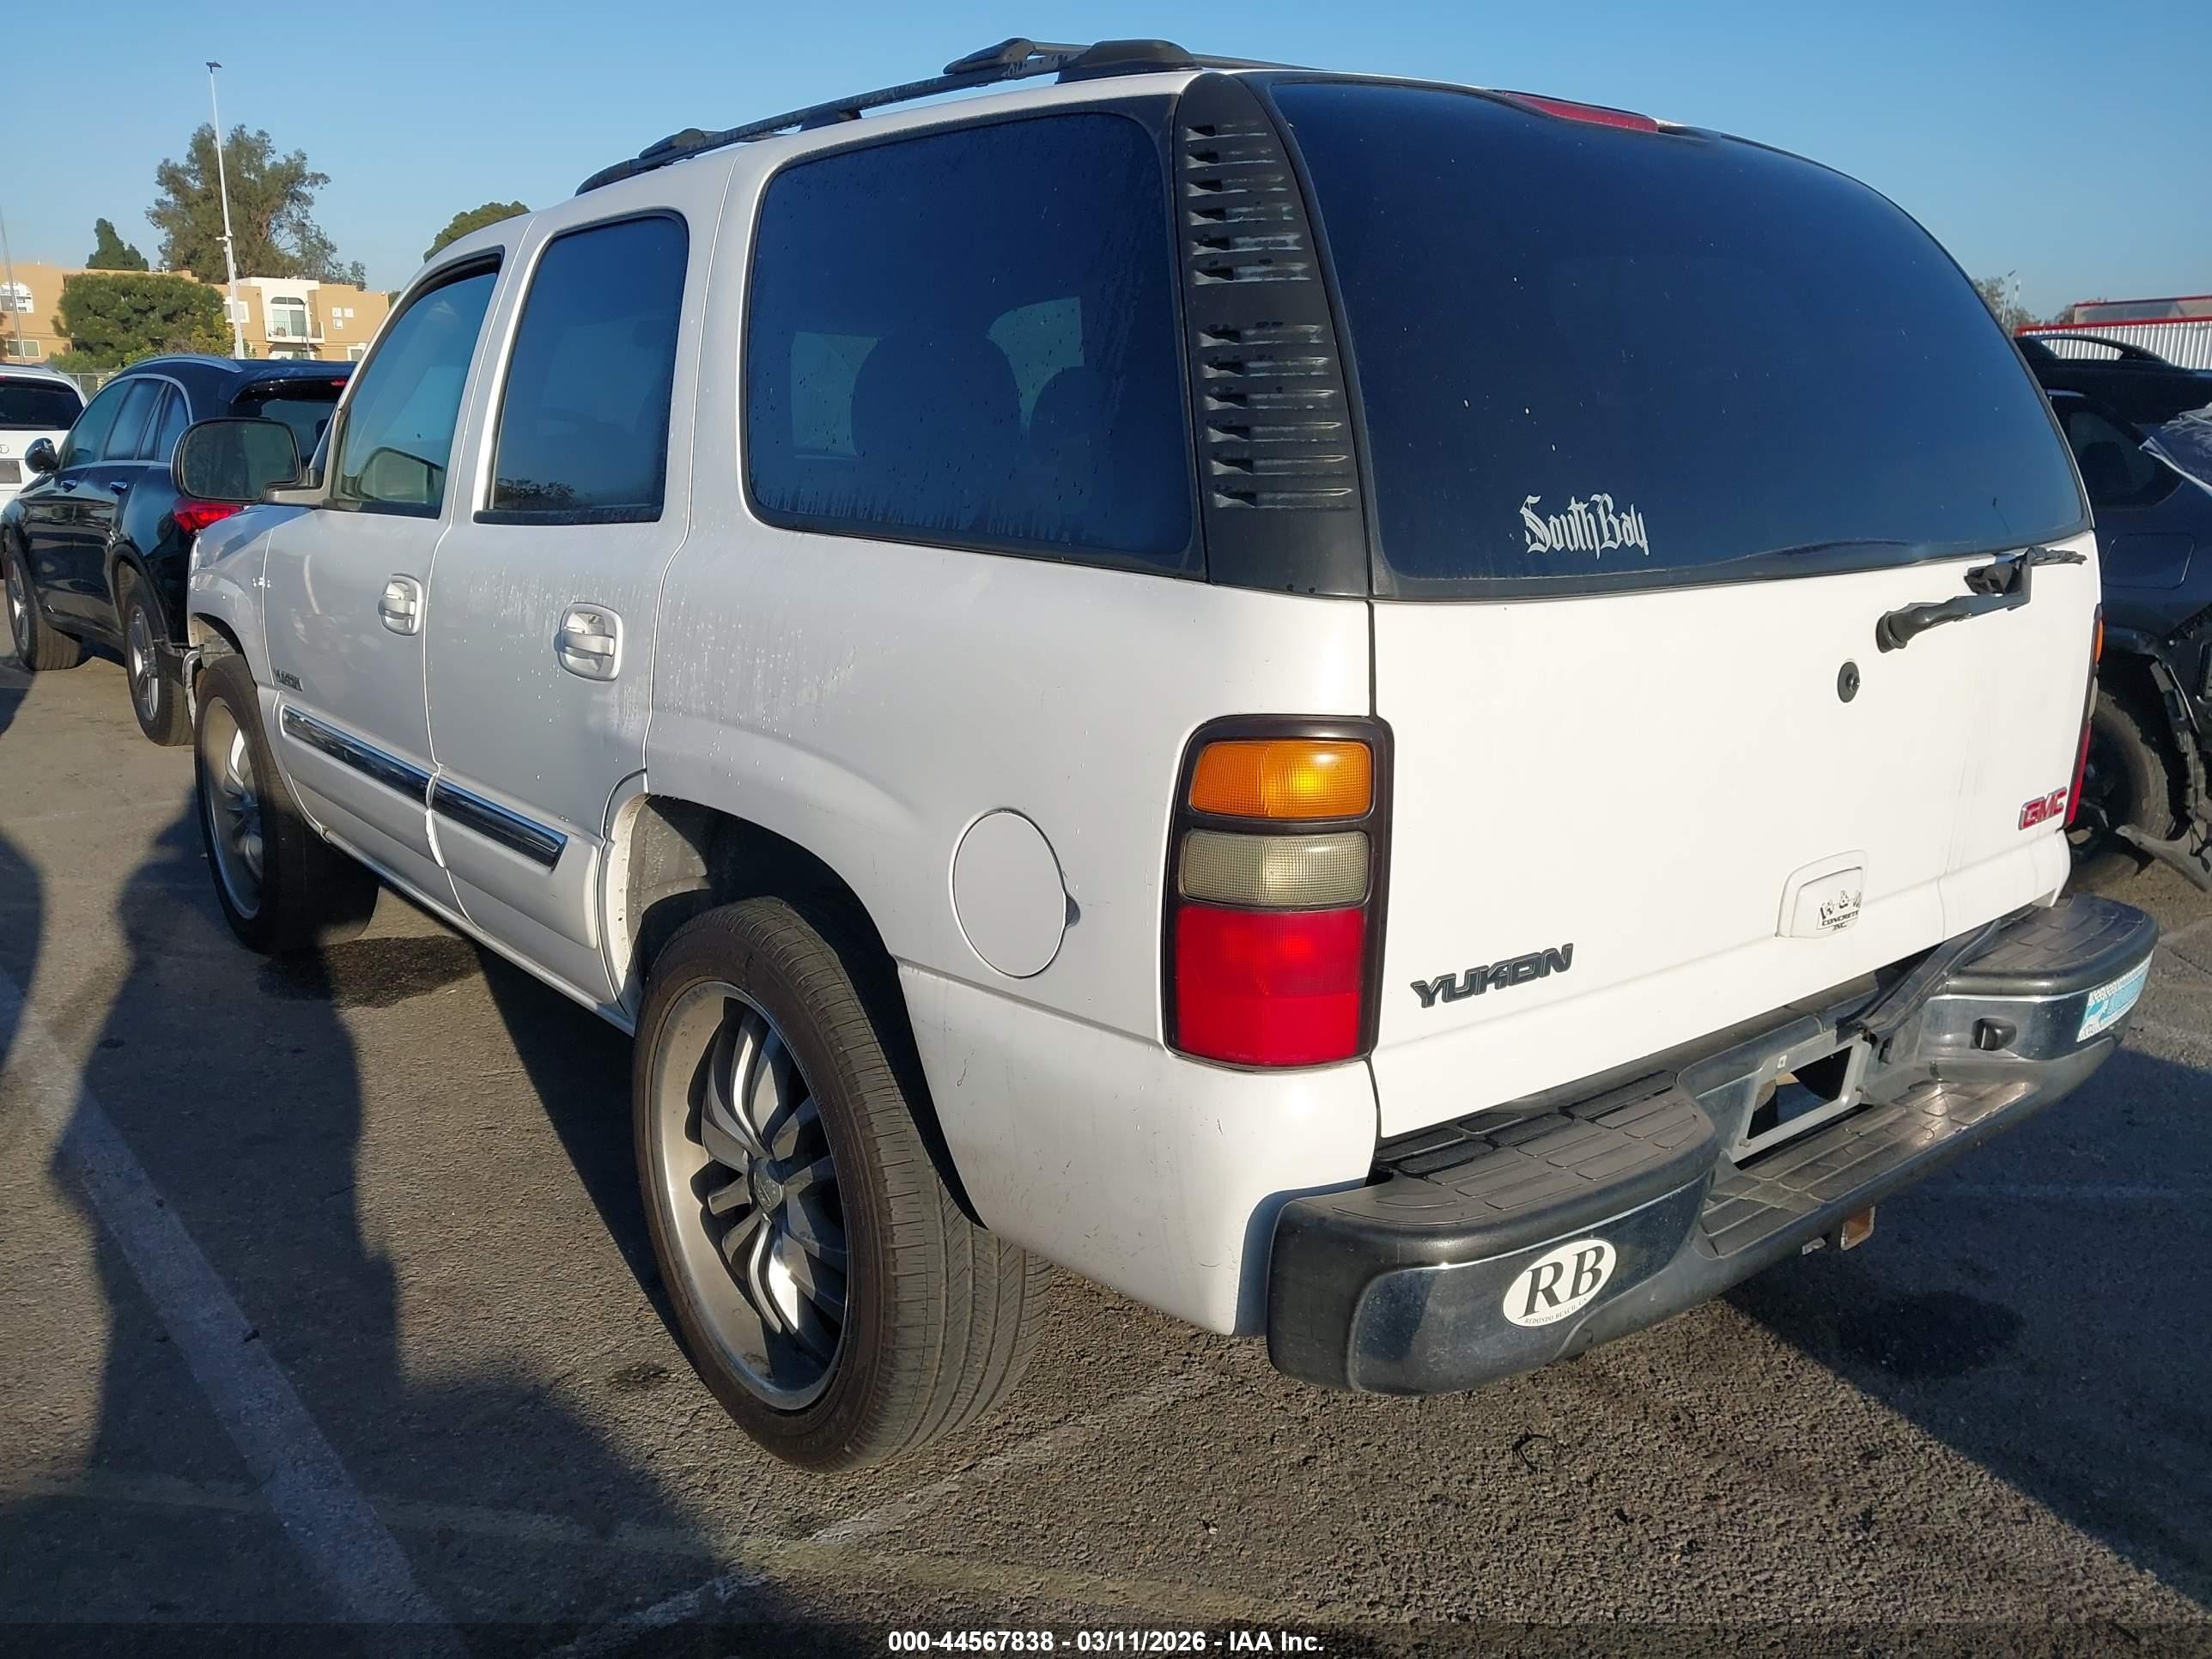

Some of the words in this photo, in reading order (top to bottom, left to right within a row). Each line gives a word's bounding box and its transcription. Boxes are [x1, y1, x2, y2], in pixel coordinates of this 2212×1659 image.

[1519, 495, 1601, 560] South
[1590, 493, 1650, 556] Bay
[2018, 786, 2068, 830] GMC
[1410, 943, 1574, 1008] YUKON
[1517, 1246, 1605, 1319] RB
[1524, 1315, 1554, 1324] REDONDO
